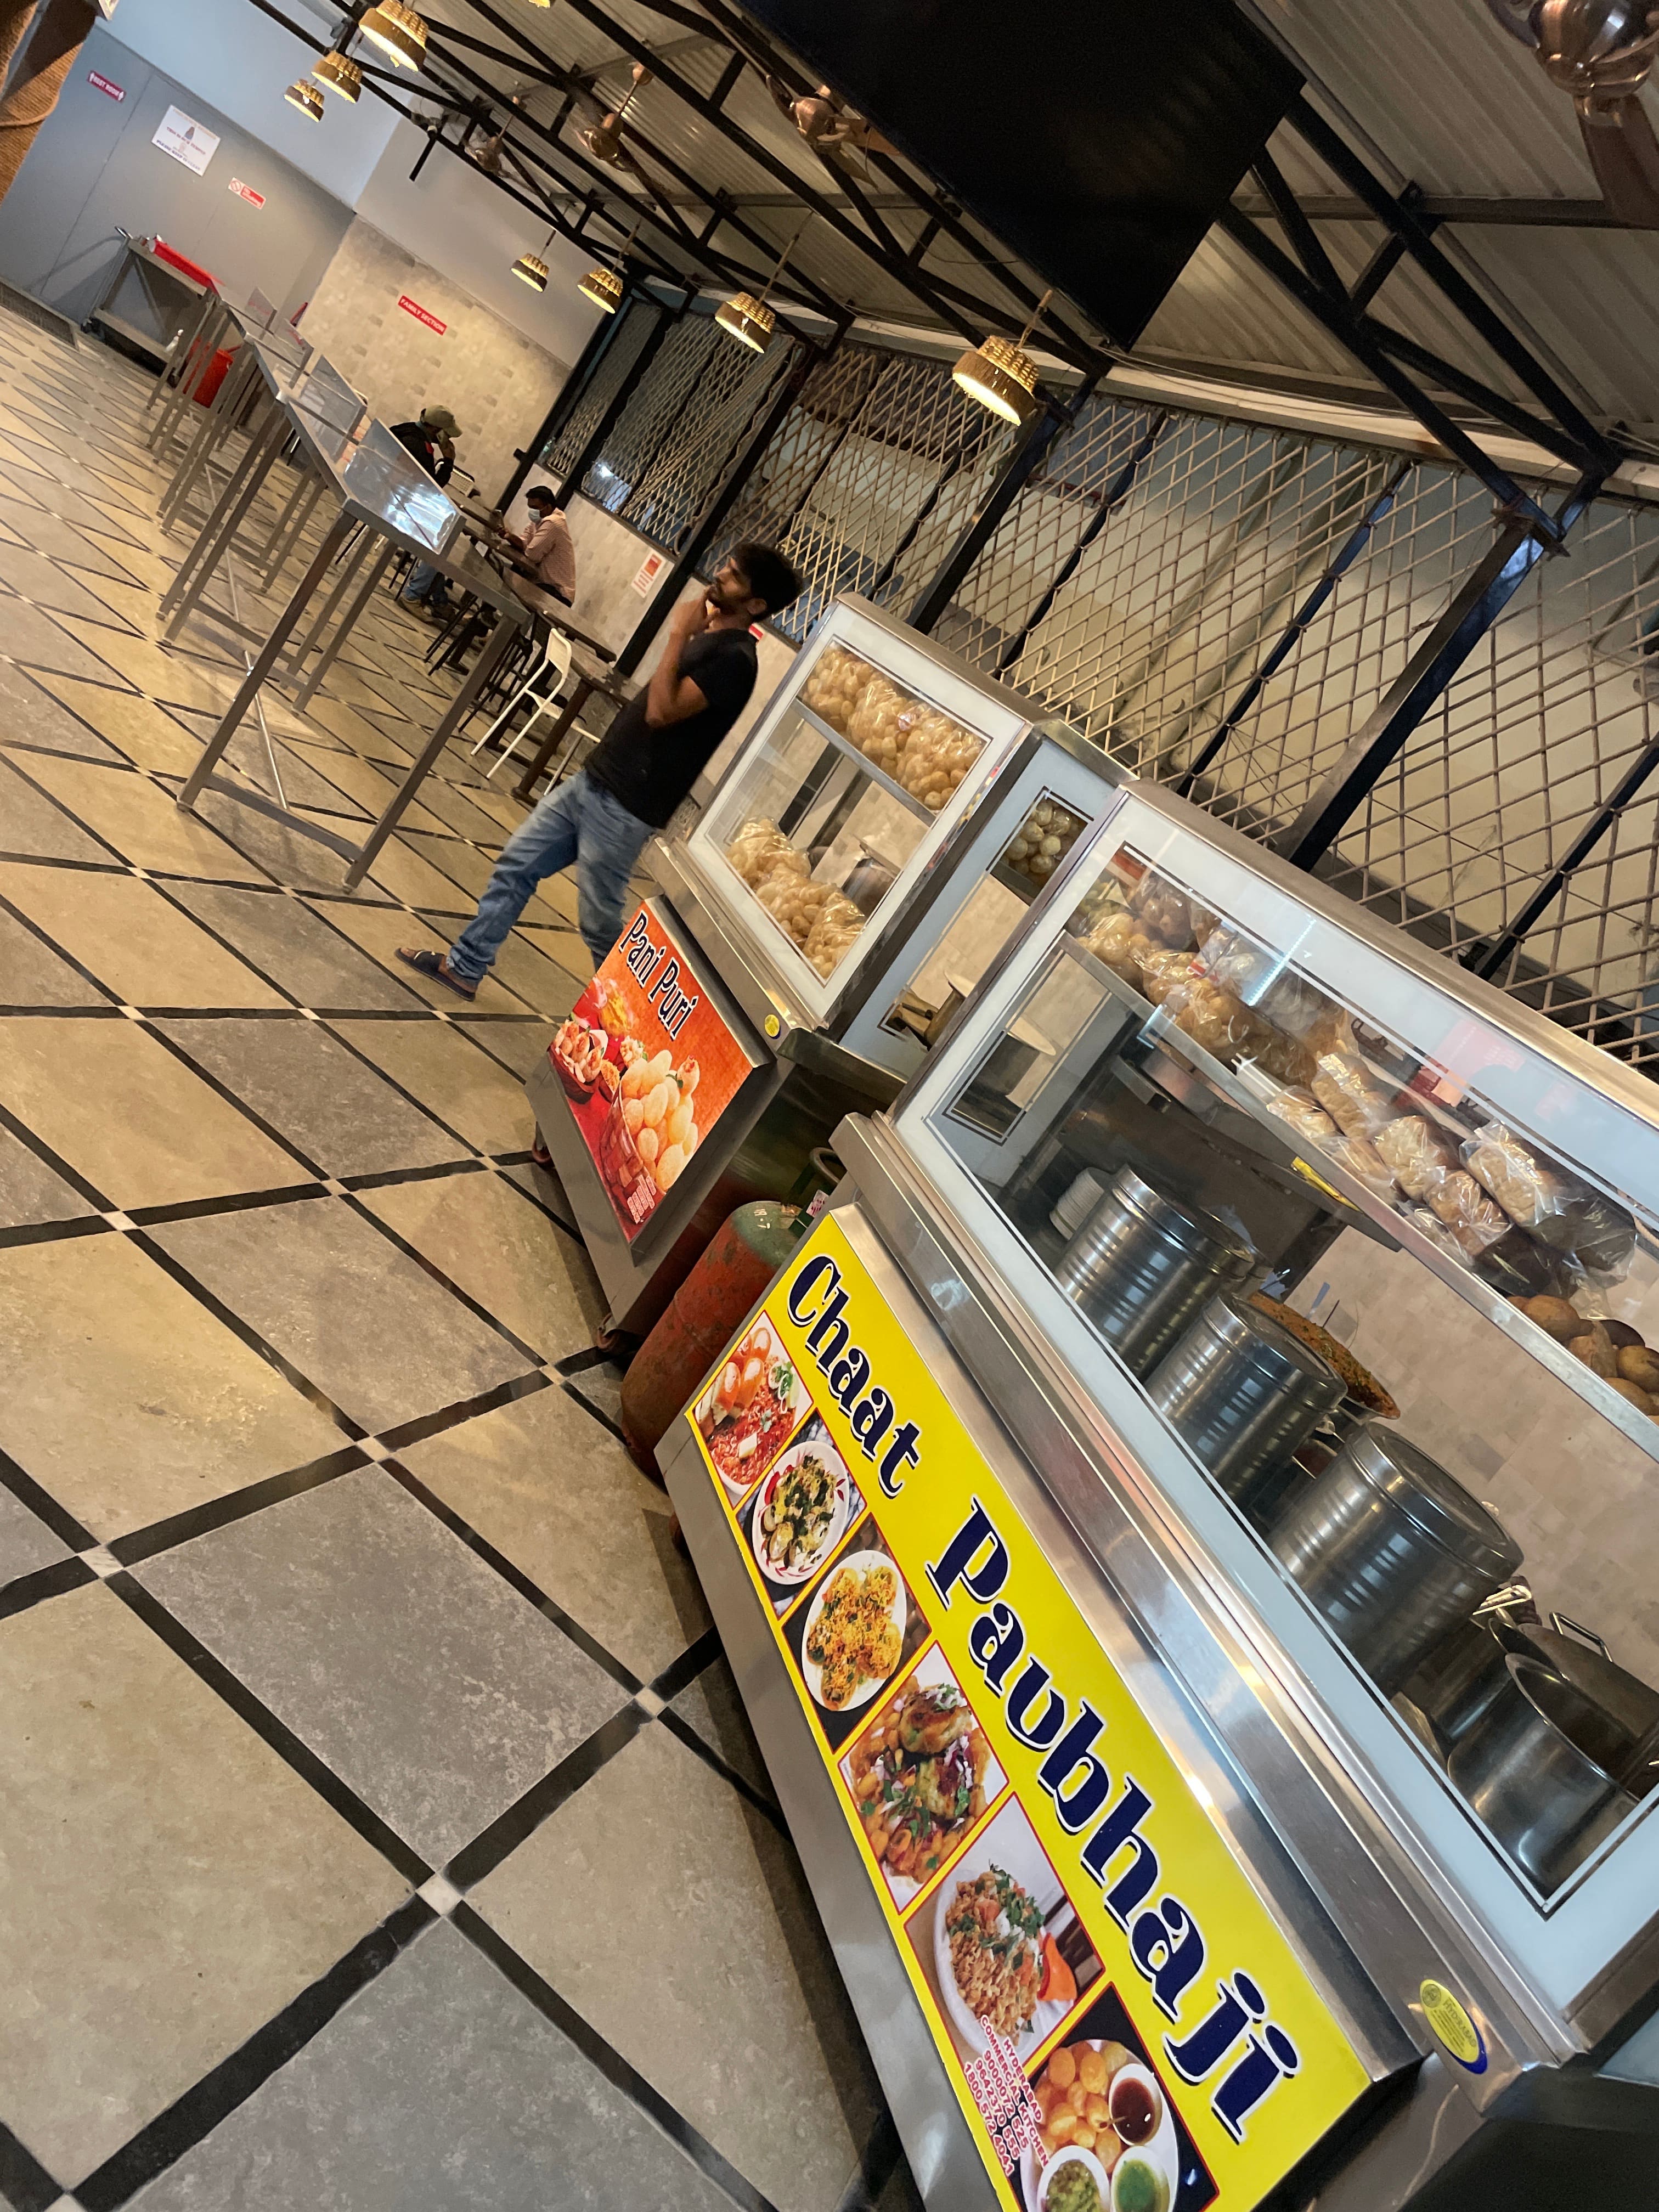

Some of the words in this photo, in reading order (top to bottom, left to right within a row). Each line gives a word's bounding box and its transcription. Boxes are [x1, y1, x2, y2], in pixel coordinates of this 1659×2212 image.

[400, 299, 421, 315] FAMILY
[421, 313, 445, 332] SECTION
[619, 910, 667, 988] Pani
[648, 957, 698, 1041] Puri
[787, 1255, 920, 1499] Chaat
[965, 2063, 983, 2100] 1800
[980, 2102, 997, 2134] 572
[994, 2136, 1013, 2174] 4041
[975, 2058, 1007, 2125] 9642370
[1003, 2127, 1021, 2158] 555
[980, 2016, 1022, 2104] COMMERCIAL
[1019, 2103, 1049, 2168] KITCHEN
[984, 2049, 1015, 2117] 9000072
[1012, 2117, 1030, 2149] 525
[1003, 2039, 1042, 2120] HYDERABAD
